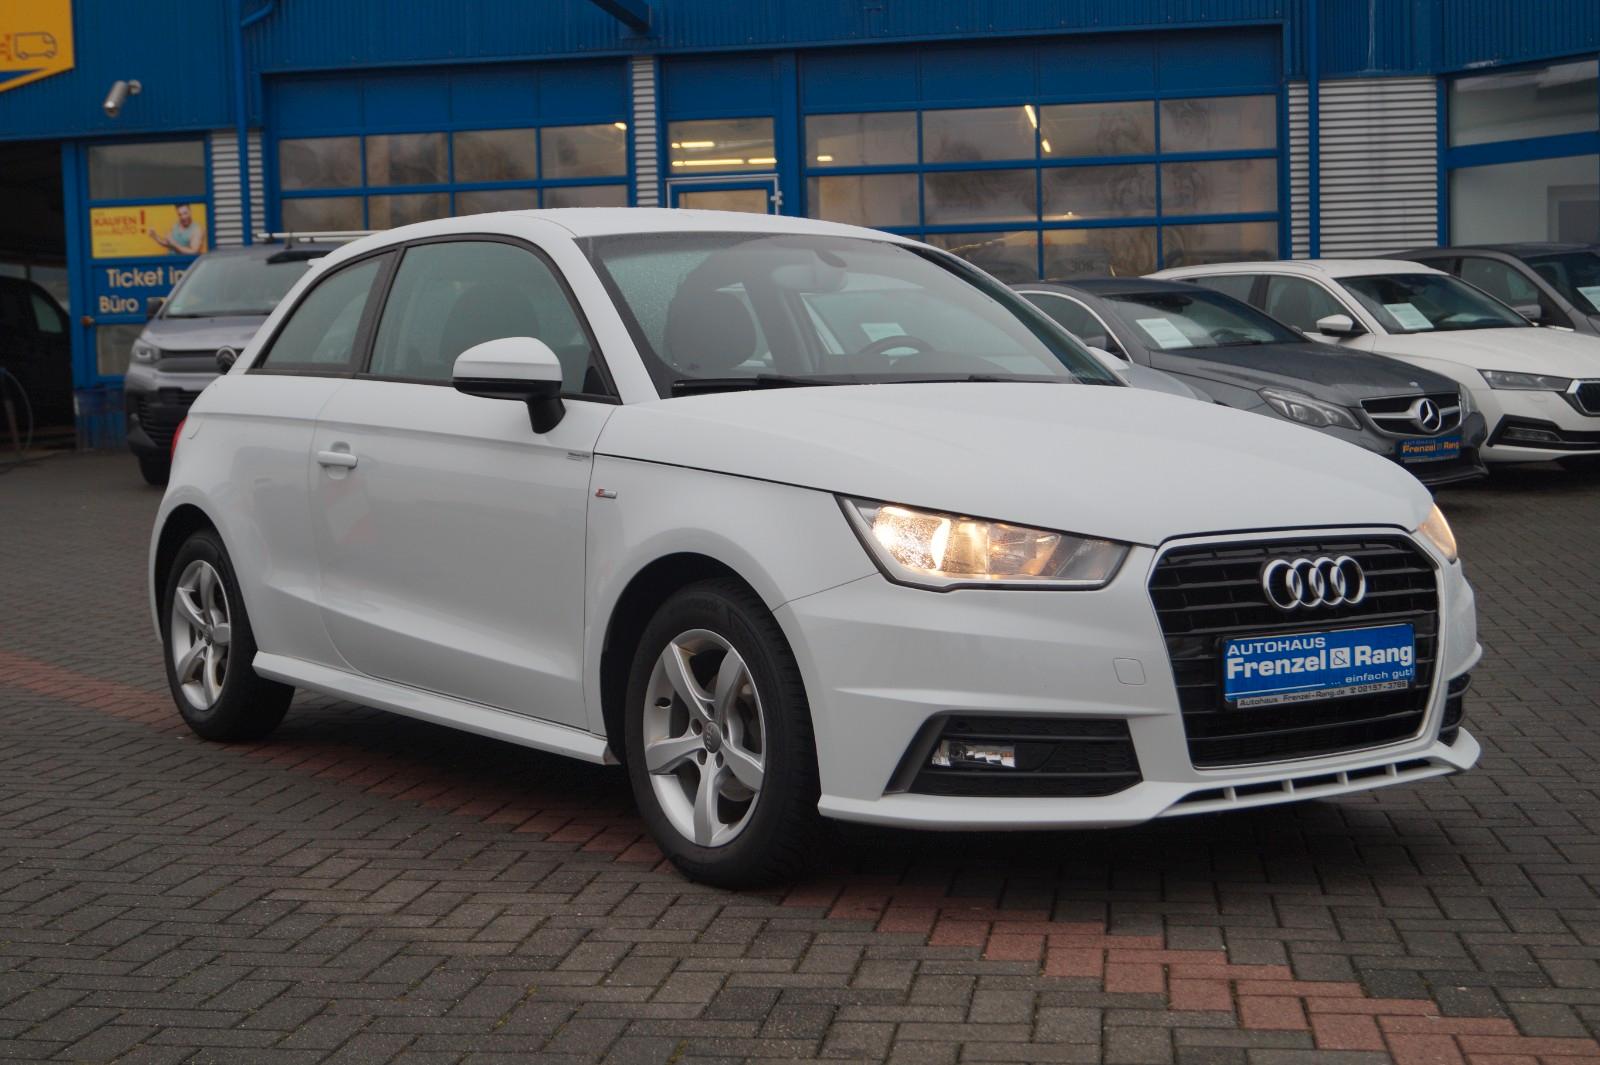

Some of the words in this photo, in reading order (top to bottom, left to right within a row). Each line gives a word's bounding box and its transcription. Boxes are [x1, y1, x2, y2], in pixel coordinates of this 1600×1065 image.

[106, 266, 163, 288] Ticket
[99, 295, 139, 313] Büro
[1227, 637, 1326, 656] AUTOHAUS
[1227, 649, 1326, 680] Frenzel
[1354, 645, 1413, 667] Rang
[1345, 672, 1388, 683] einfach
[1392, 668, 1413, 680] gut!
[1239, 697, 1278, 706] Autohaus
